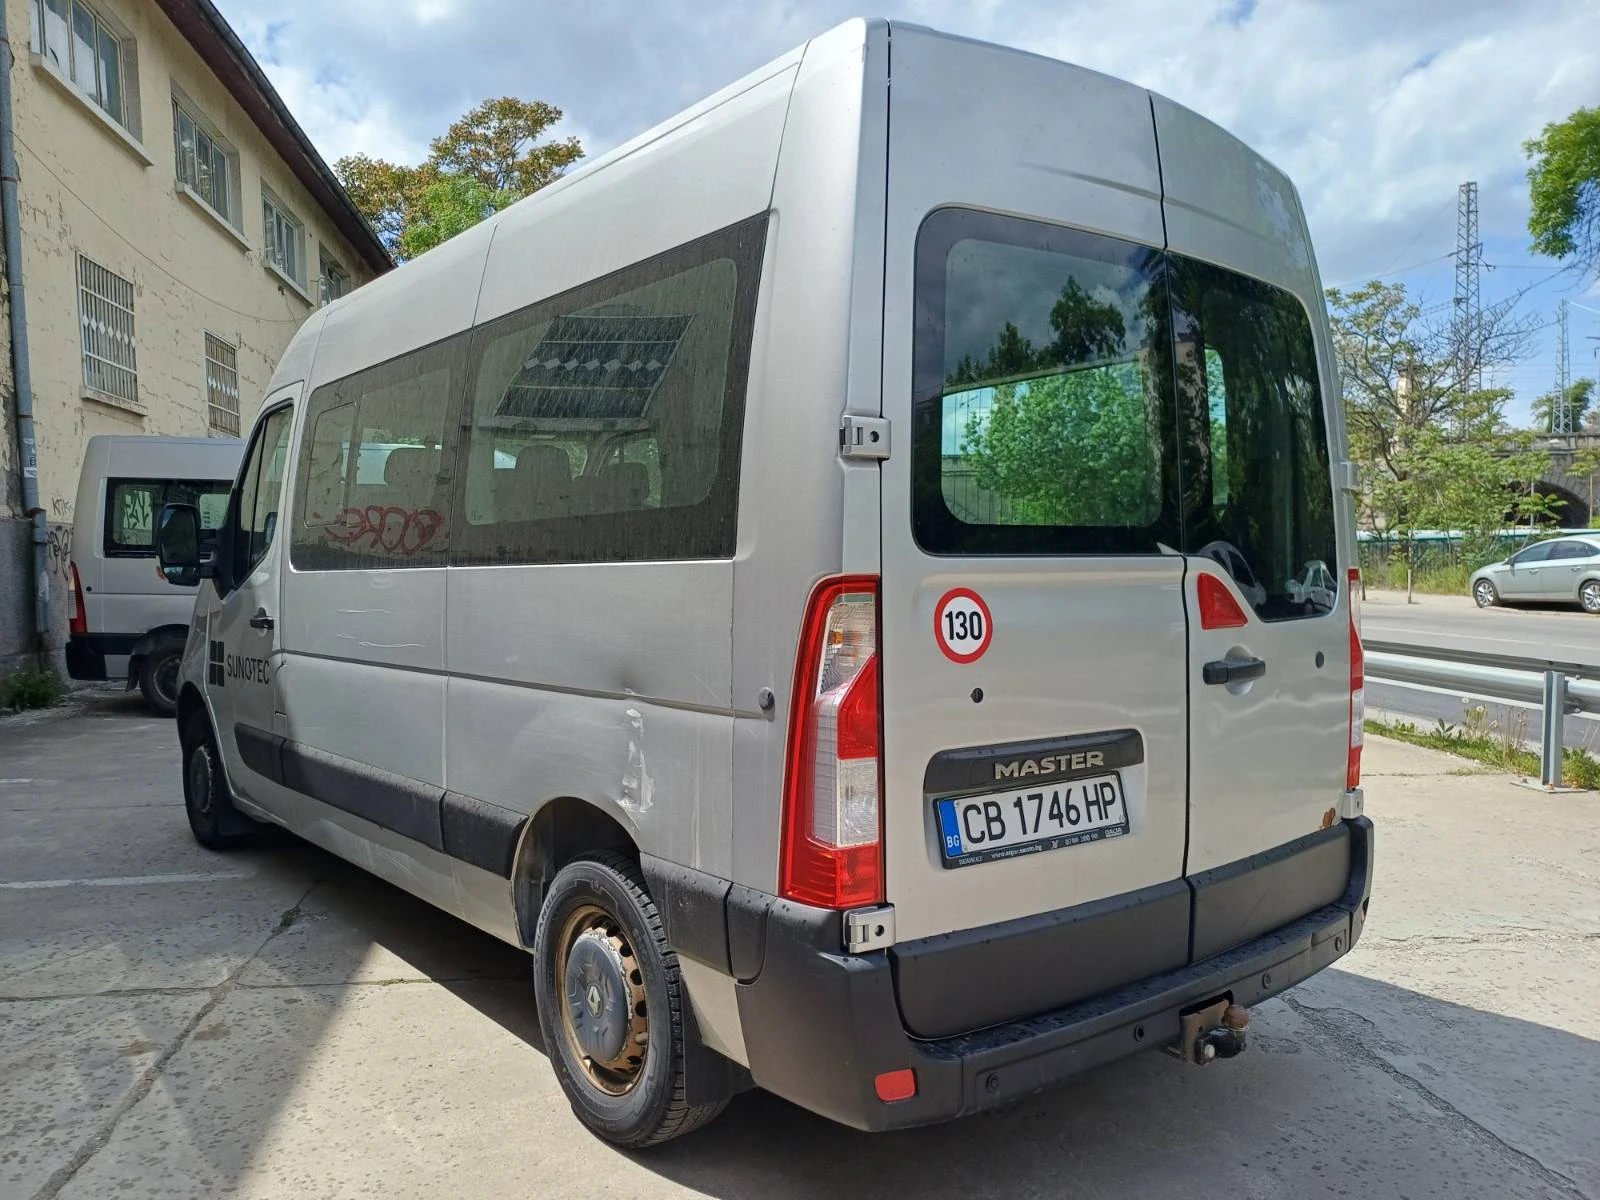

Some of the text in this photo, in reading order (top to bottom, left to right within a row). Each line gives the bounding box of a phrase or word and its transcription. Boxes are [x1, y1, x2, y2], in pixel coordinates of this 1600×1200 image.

[945, 610, 983, 641] 130
[227, 653, 270, 685] SUNOTEC
[994, 750, 1105, 780] MASTER
[962, 781, 1117, 845] CB 1746 HP
[947, 834, 960, 848] BG
